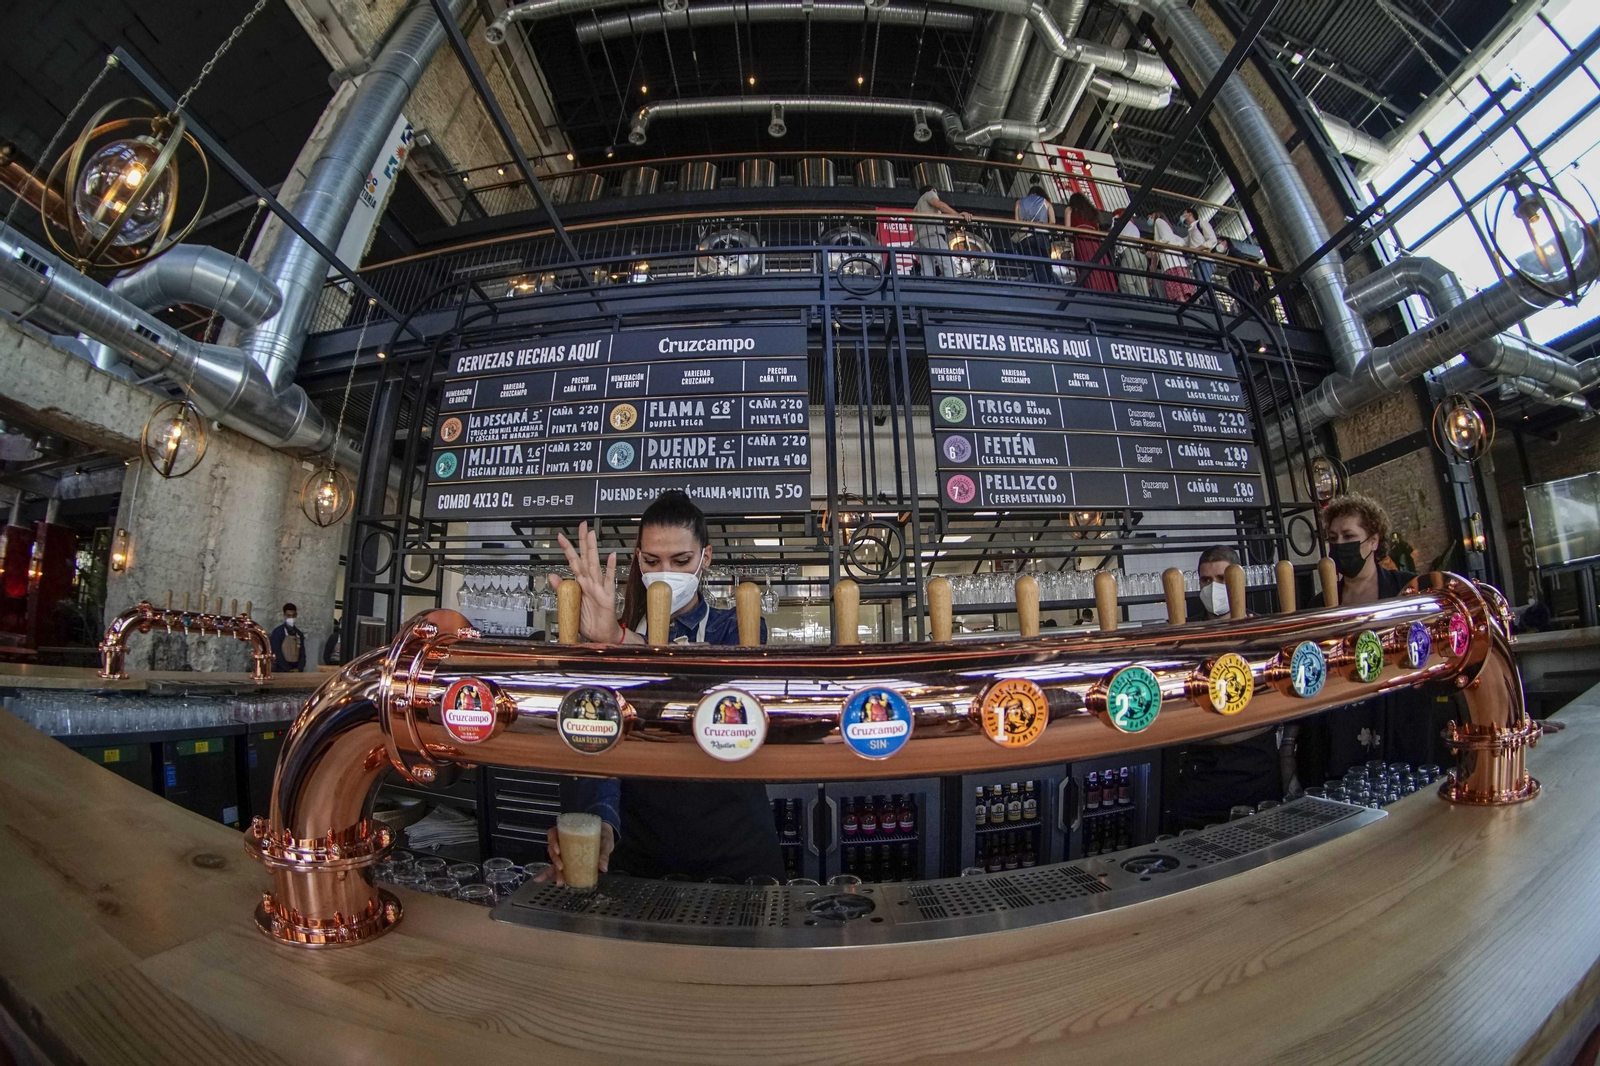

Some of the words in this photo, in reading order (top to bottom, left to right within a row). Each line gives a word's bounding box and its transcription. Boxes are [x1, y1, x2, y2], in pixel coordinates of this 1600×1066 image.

[658, 337, 755, 353] Cruzcampo
[938, 332, 1006, 352] CERVEZAS
[1009, 336, 1060, 354] HECHAS
[1063, 340, 1091, 358] AQUÍ
[457, 351, 514, 373] CERVEZAS
[516, 345, 565, 366] HECHAS
[568, 340, 602, 362] AQUÍ
[1110, 344, 1168, 364] CERVEZAS
[1169, 350, 1184, 366] DE
[1185, 352, 1222, 371] BARRIL
[931, 367, 964, 375] NUMERACIÓN
[572, 376, 590, 384] PRECIO
[611, 373, 644, 382] NUMERACIÓN
[681, 377, 714, 385] CRUZCAMPO
[1001, 376, 1031, 384] CRUZCAMPO
[1121, 374, 1148, 385] Cruzcampo
[503, 382, 525, 390] VARIEDAD
[564, 384, 576, 393] CAÑA
[582, 383, 597, 392] PINTA
[1123, 383, 1143, 392] Especial
[1165, 377, 1199, 390] CAÑÓN
[500, 389, 528, 398] CRUZCAMPO
[1187, 392, 1206, 400] LAGER
[1207, 393, 1230, 401] ESPECIAL
[650, 401, 705, 417] FLAMA
[749, 398, 777, 409] CAÑA
[780, 399, 802, 409] 2'20
[978, 400, 1021, 414] TRIGO
[552, 406, 573, 416] CAÑA
[946, 407, 951, 419] 5
[1027, 407, 1052, 415] RAMA
[1128, 408, 1155, 418] Cruzcampo
[1172, 408, 1206, 423] CAÑÓN
[470, 416, 480, 428] LA
[483, 408, 528, 427] DESCARÁ
[614, 414, 621, 427] 3
[750, 414, 781, 425] PINTA
[783, 412, 803, 424] 4'00
[981, 415, 1047, 425] (COSECHANDO)
[1130, 418, 1142, 427] Gran
[1143, 419, 1162, 428] Reserva
[519, 424, 543, 432] AZAHAR
[552, 424, 578, 434] PINTA
[650, 420, 676, 428] DUBBEL
[444, 428, 450, 438] 1
[1220, 426, 1237, 434] LAGER
[748, 434, 776, 446] CAÑA
[782, 435, 806, 446] 2'20
[984, 433, 1036, 455] FETÉN
[548, 442, 570, 452] CAÑA
[648, 437, 716, 457] DUENDE
[1135, 444, 1162, 455] Cruzcampo
[1178, 443, 1211, 458] CAÑÓN
[468, 444, 523, 466] MIJITA
[950, 447, 956, 459] 6
[1137, 454, 1152, 463] Radler
[611, 453, 618, 466] 4
[650, 458, 708, 469] AMERICAN
[716, 456, 735, 468] IPA
[748, 456, 780, 466] PINTA
[784, 453, 807, 466] 4'00
[981, 456, 994, 464] (LE
[438, 462, 445, 474] 2
[468, 467, 497, 477] BELGIAN
[499, 466, 523, 476] BLONDE
[526, 465, 539, 475] ALE
[546, 462, 569, 472] PINTA
[986, 474, 1057, 490] PELLIZCO
[1141, 480, 1168, 490] Cruzcampo
[1187, 479, 1218, 493] CAÑÓN
[601, 488, 642, 501] DUENDE
[697, 486, 726, 499] FLAMA
[732, 486, 770, 499] MIJITA
[952, 487, 958, 500] 7
[990, 493, 1066, 504] (FERMENTANDO)
[1143, 490, 1152, 498] Sin
[438, 494, 470, 510] COMBO
[472, 492, 499, 508] 4X13
[1450, 631, 1458, 652] 7
[1411, 641, 1418, 666] 6
[1360, 653, 1368, 679] 5
[1296, 665, 1306, 694] 4
[1216, 679, 1226, 710] 3
[1116, 694, 1128, 725] 2
[449, 713, 488, 723] Cruzcampo
[566, 722, 613, 733] Cruzcampo
[993, 707, 1008, 741] 1
[704, 727, 756, 737] Cruzcampo
[852, 725, 904, 736] Cruzcampo
[587, 736, 608, 744] RESERVA
[870, 739, 887, 749] SIN
